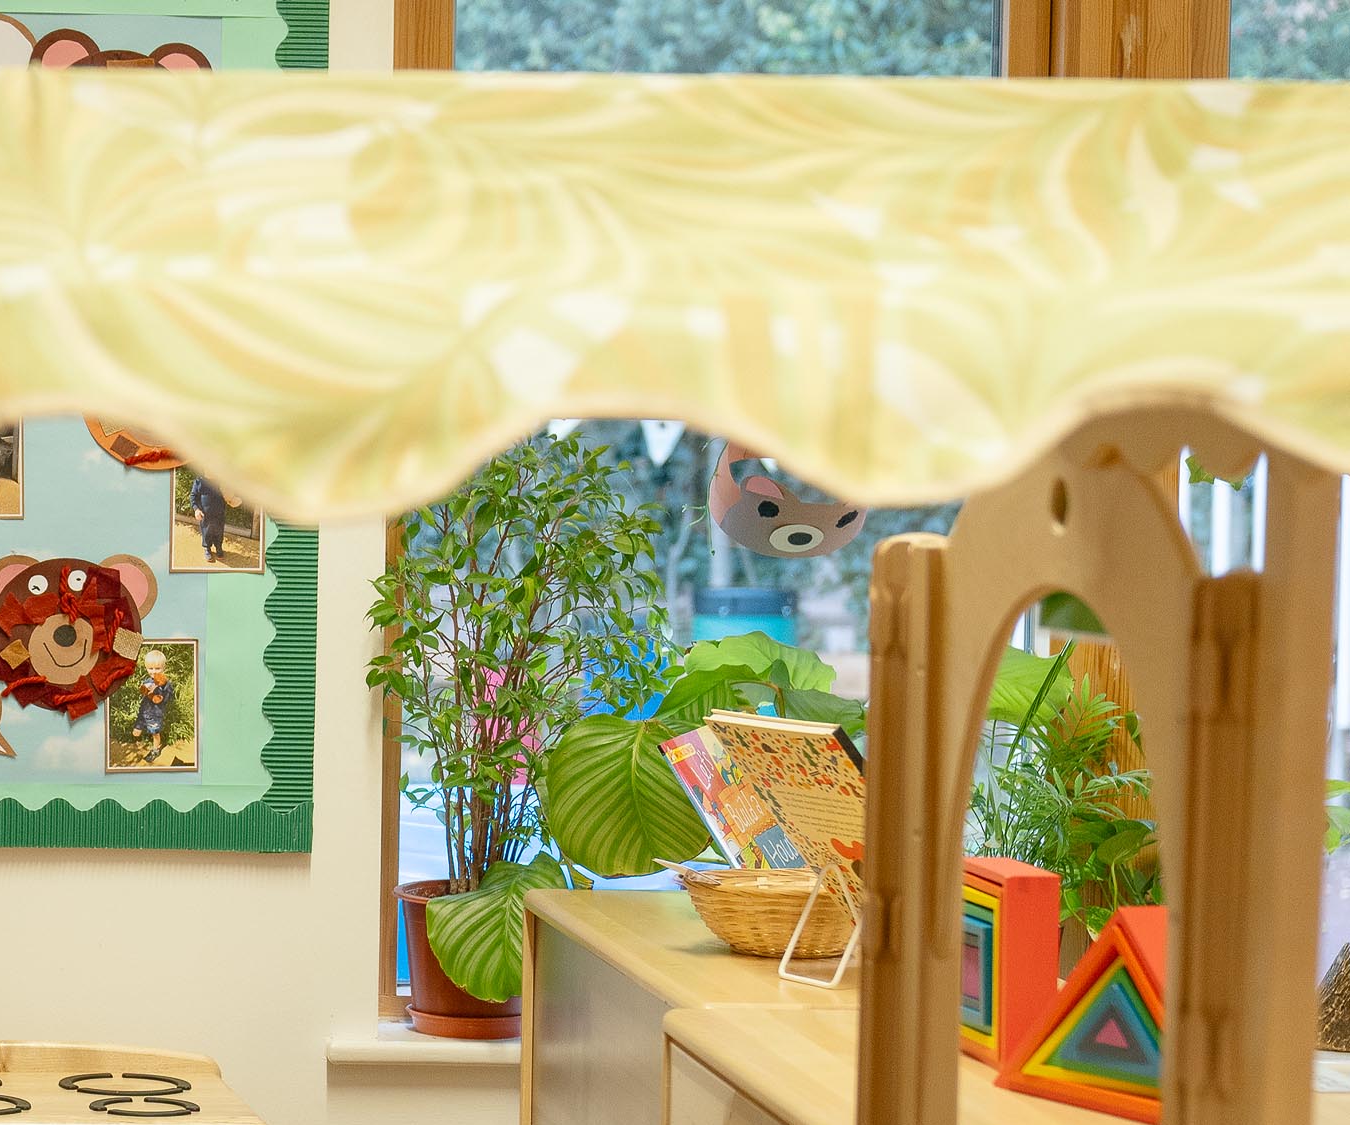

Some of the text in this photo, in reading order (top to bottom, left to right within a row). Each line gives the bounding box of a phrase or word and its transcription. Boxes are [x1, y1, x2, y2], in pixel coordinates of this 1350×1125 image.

[691, 749, 715, 790] Let's
[724, 790, 759, 834] Build
[750, 795, 765, 816] a
